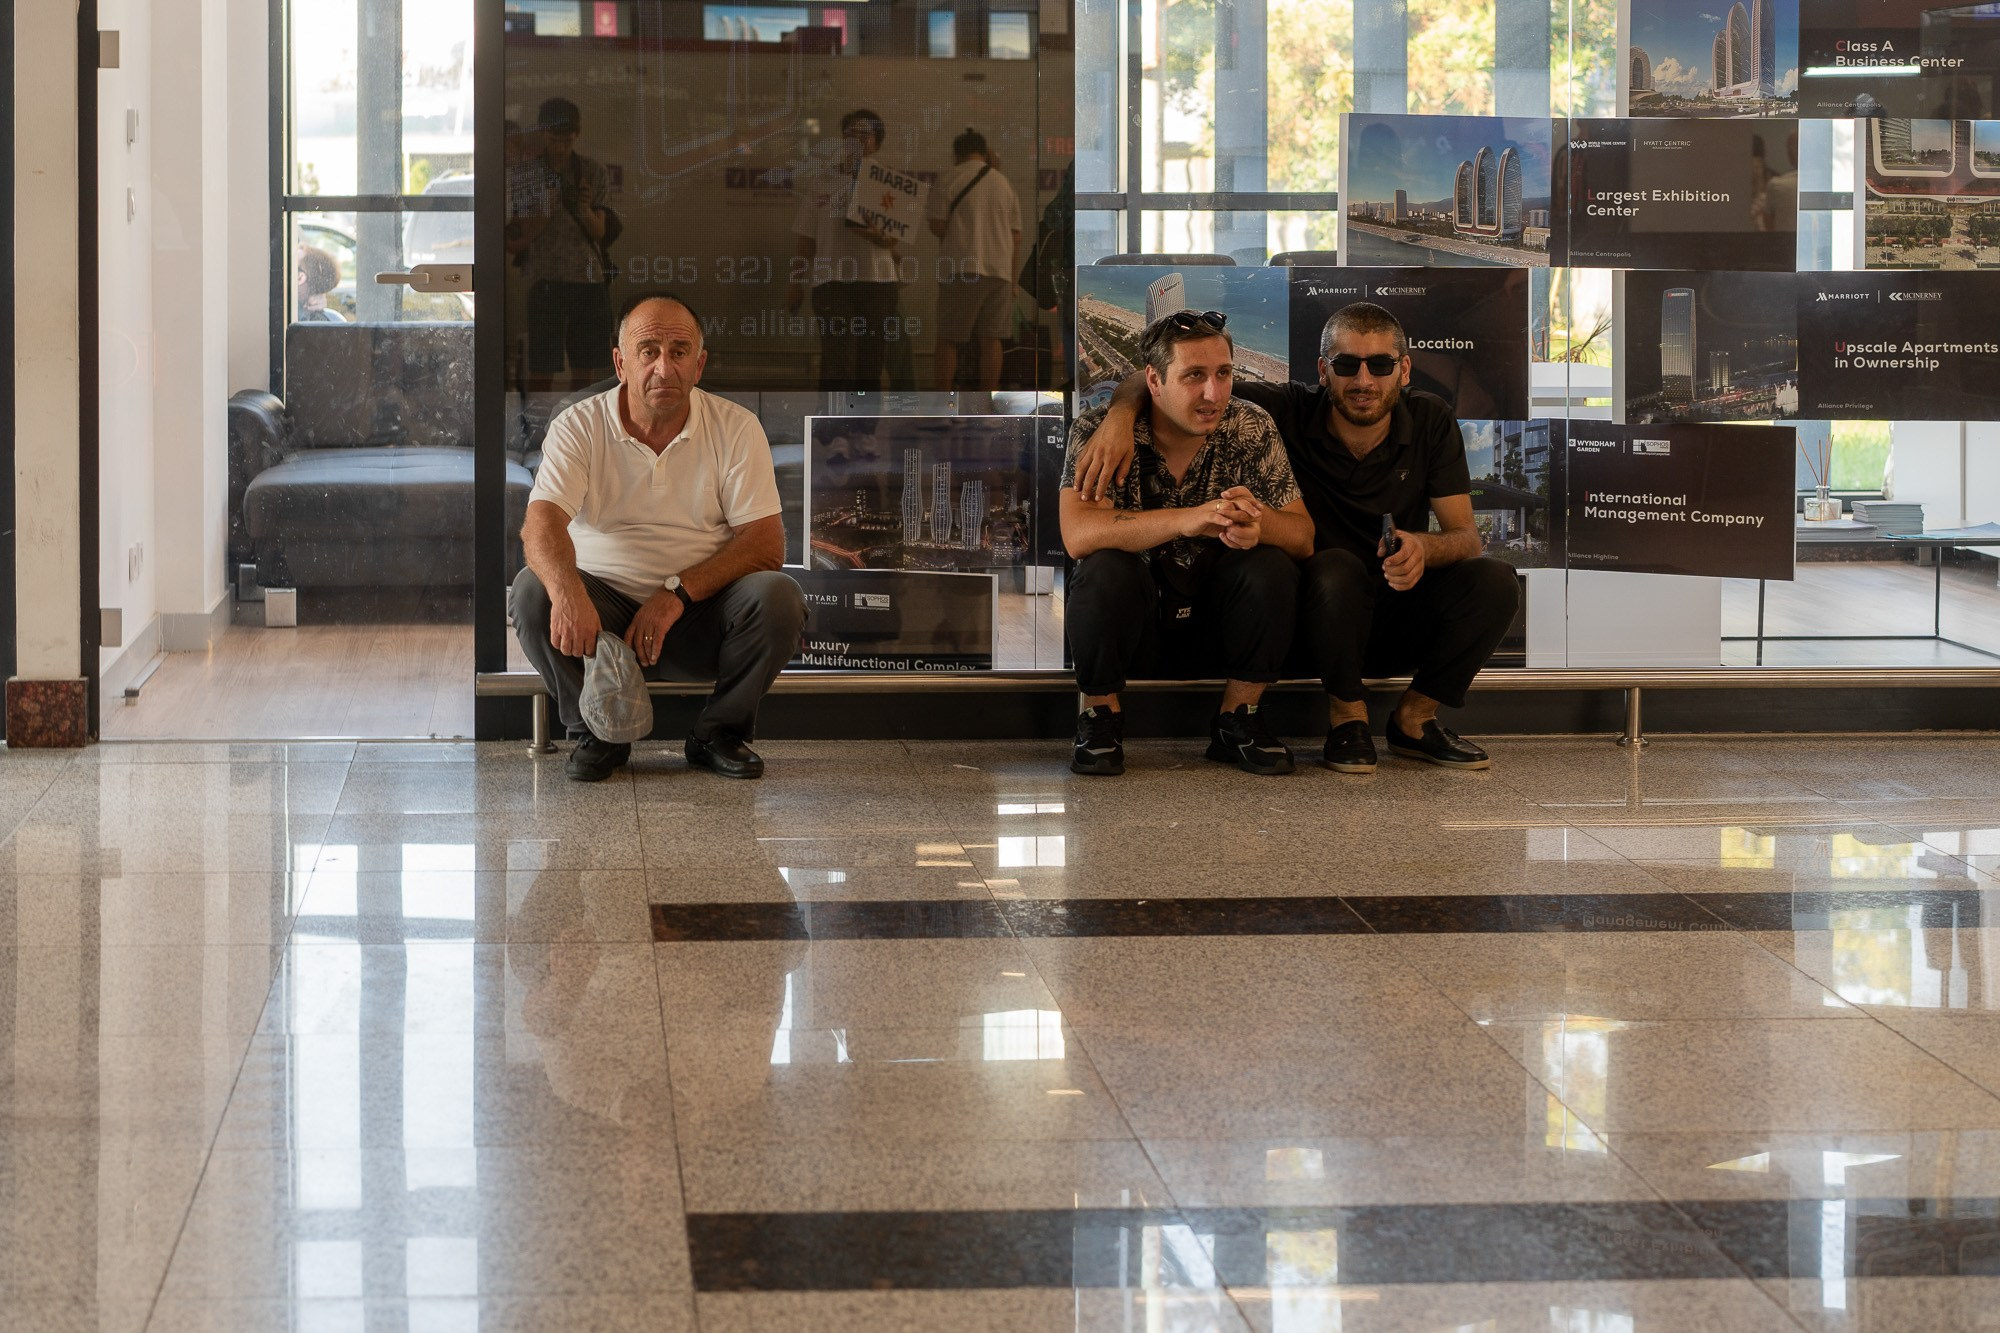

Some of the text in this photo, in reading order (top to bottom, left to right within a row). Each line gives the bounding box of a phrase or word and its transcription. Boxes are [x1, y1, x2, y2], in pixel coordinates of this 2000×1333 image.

[1836, 40, 1894, 52] Class A
[1835, 56, 1965, 68] Business Center
[1587, 188, 1730, 204] Largest Exhibition
[1586, 204, 1640, 217] Center
[586, 256, 981, 284] (+995 32) 250 00 00
[701, 309, 921, 341] w.alliance.ge
[1409, 337, 1474, 349] Location
[1835, 341, 1999, 356] Upscale Apartments
[1834, 356, 1940, 371] in Ownership
[1844, 403, 1874, 411] Privilege
[1576, 440, 1616, 448] WYNDHAM
[1584, 490, 1687, 506] International
[1584, 506, 1765, 528] Management Company
[1593, 553, 1619, 561] Highline
[803, 593, 838, 602] RTYARD
[801, 638, 850, 654] Luxury
[801, 653, 910, 670] Multifunctional
